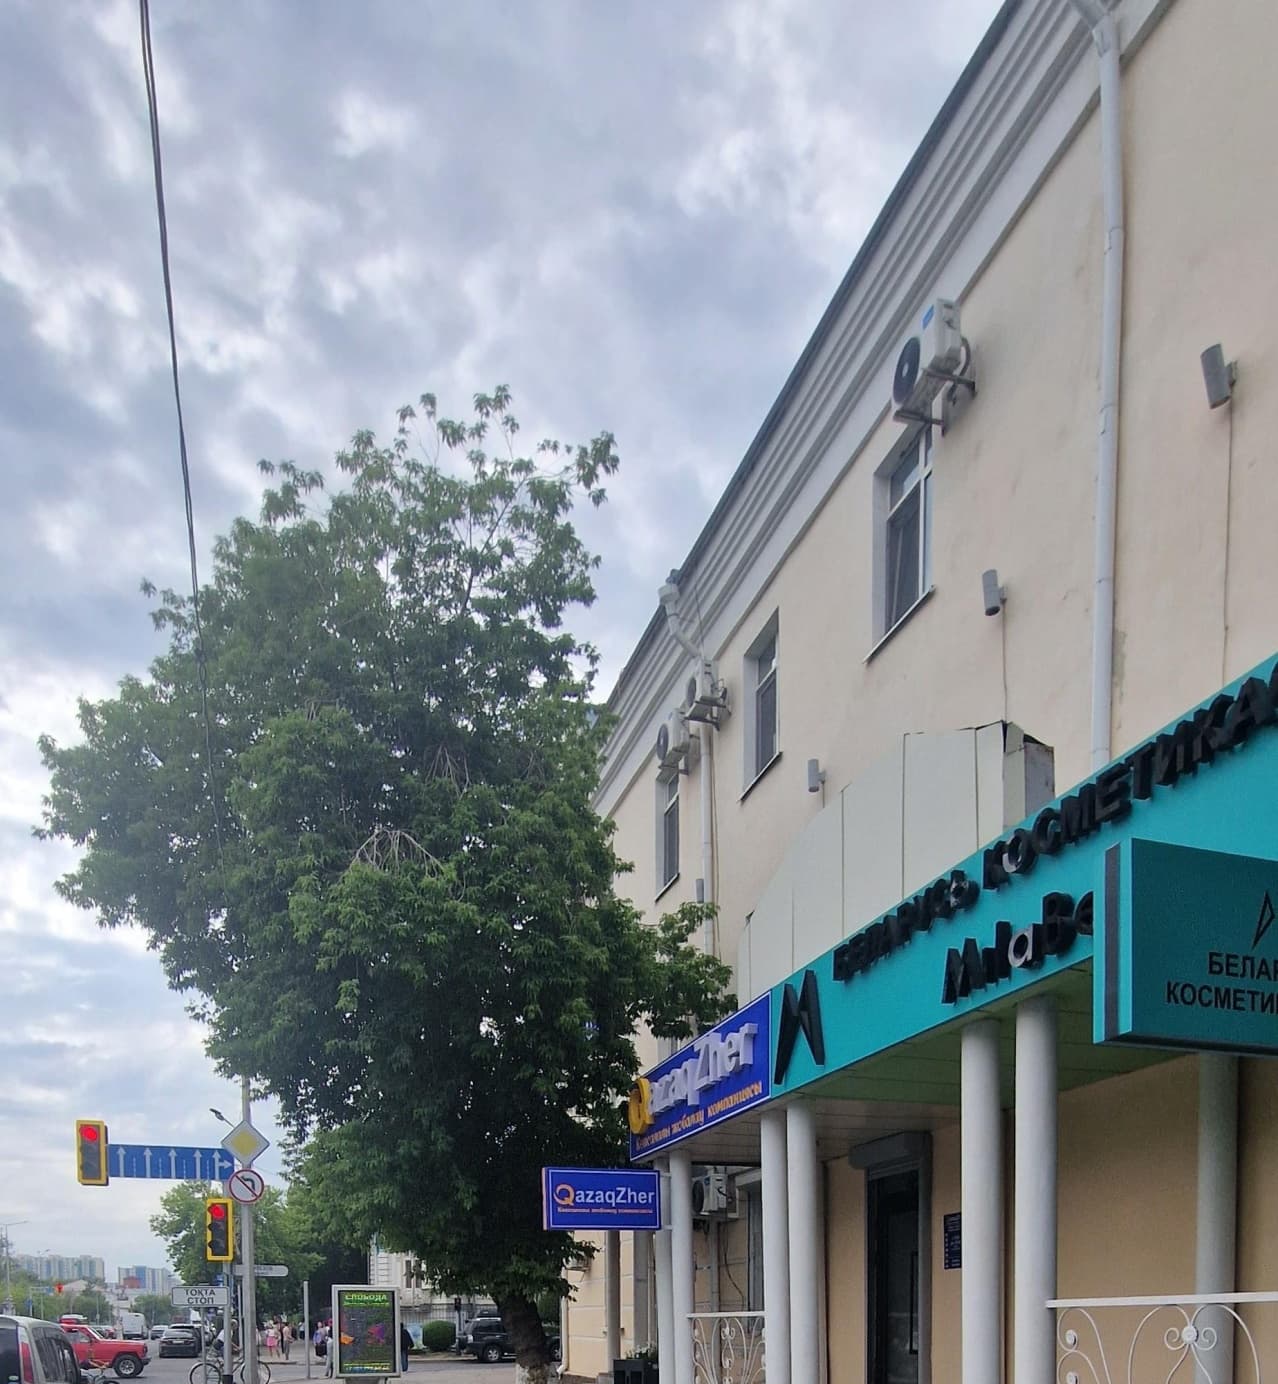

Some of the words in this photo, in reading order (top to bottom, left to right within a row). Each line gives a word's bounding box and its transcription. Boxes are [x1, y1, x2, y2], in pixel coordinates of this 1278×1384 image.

[1166, 980, 1278, 1014] КОСМЕТИ
[628, 1022, 758, 1134] QazaqZher
[553, 1183, 655, 1207] QazaqZher
[187, 1297, 214, 1305] СТОП
